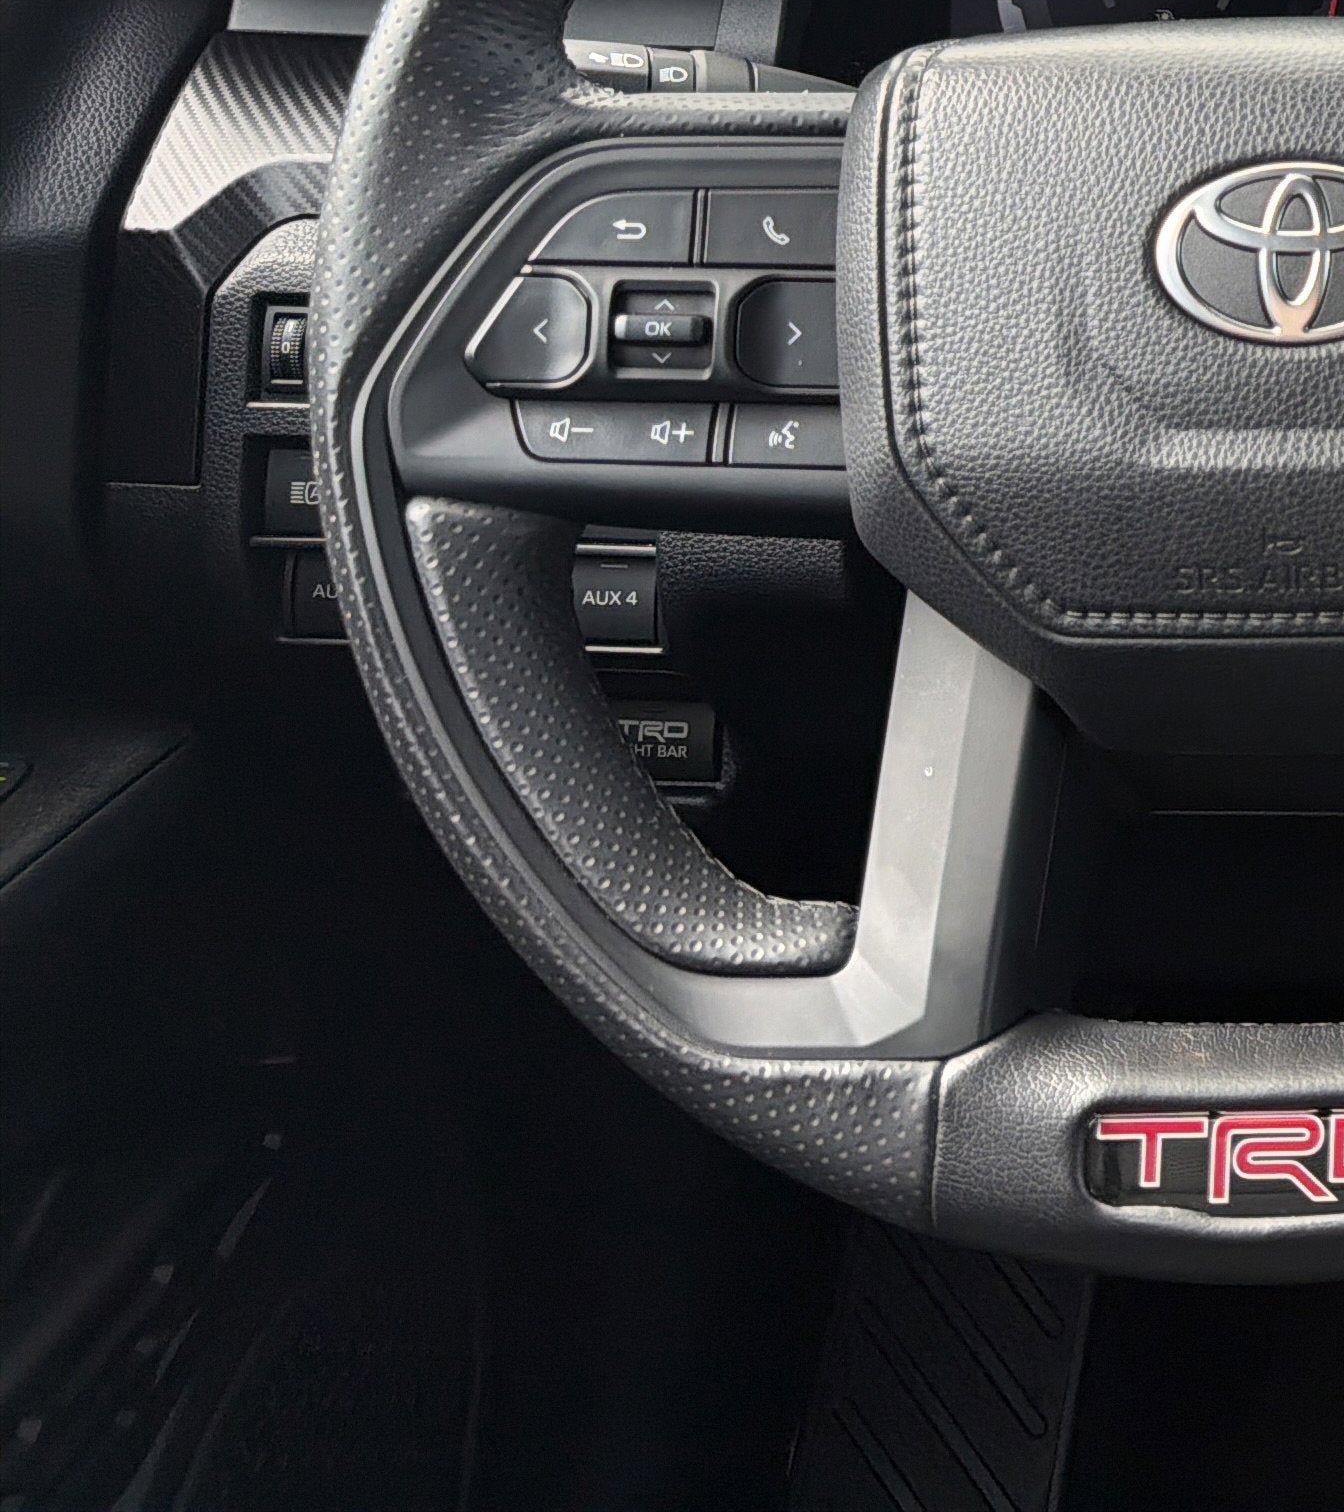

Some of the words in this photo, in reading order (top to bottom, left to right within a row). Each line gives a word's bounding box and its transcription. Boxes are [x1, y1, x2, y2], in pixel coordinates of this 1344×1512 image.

[644, 321, 672, 337] OK
[581, 591, 622, 606] AUX
[625, 591, 637, 606] 4
[618, 719, 689, 743] TRD
[657, 744, 688, 759] BAR
